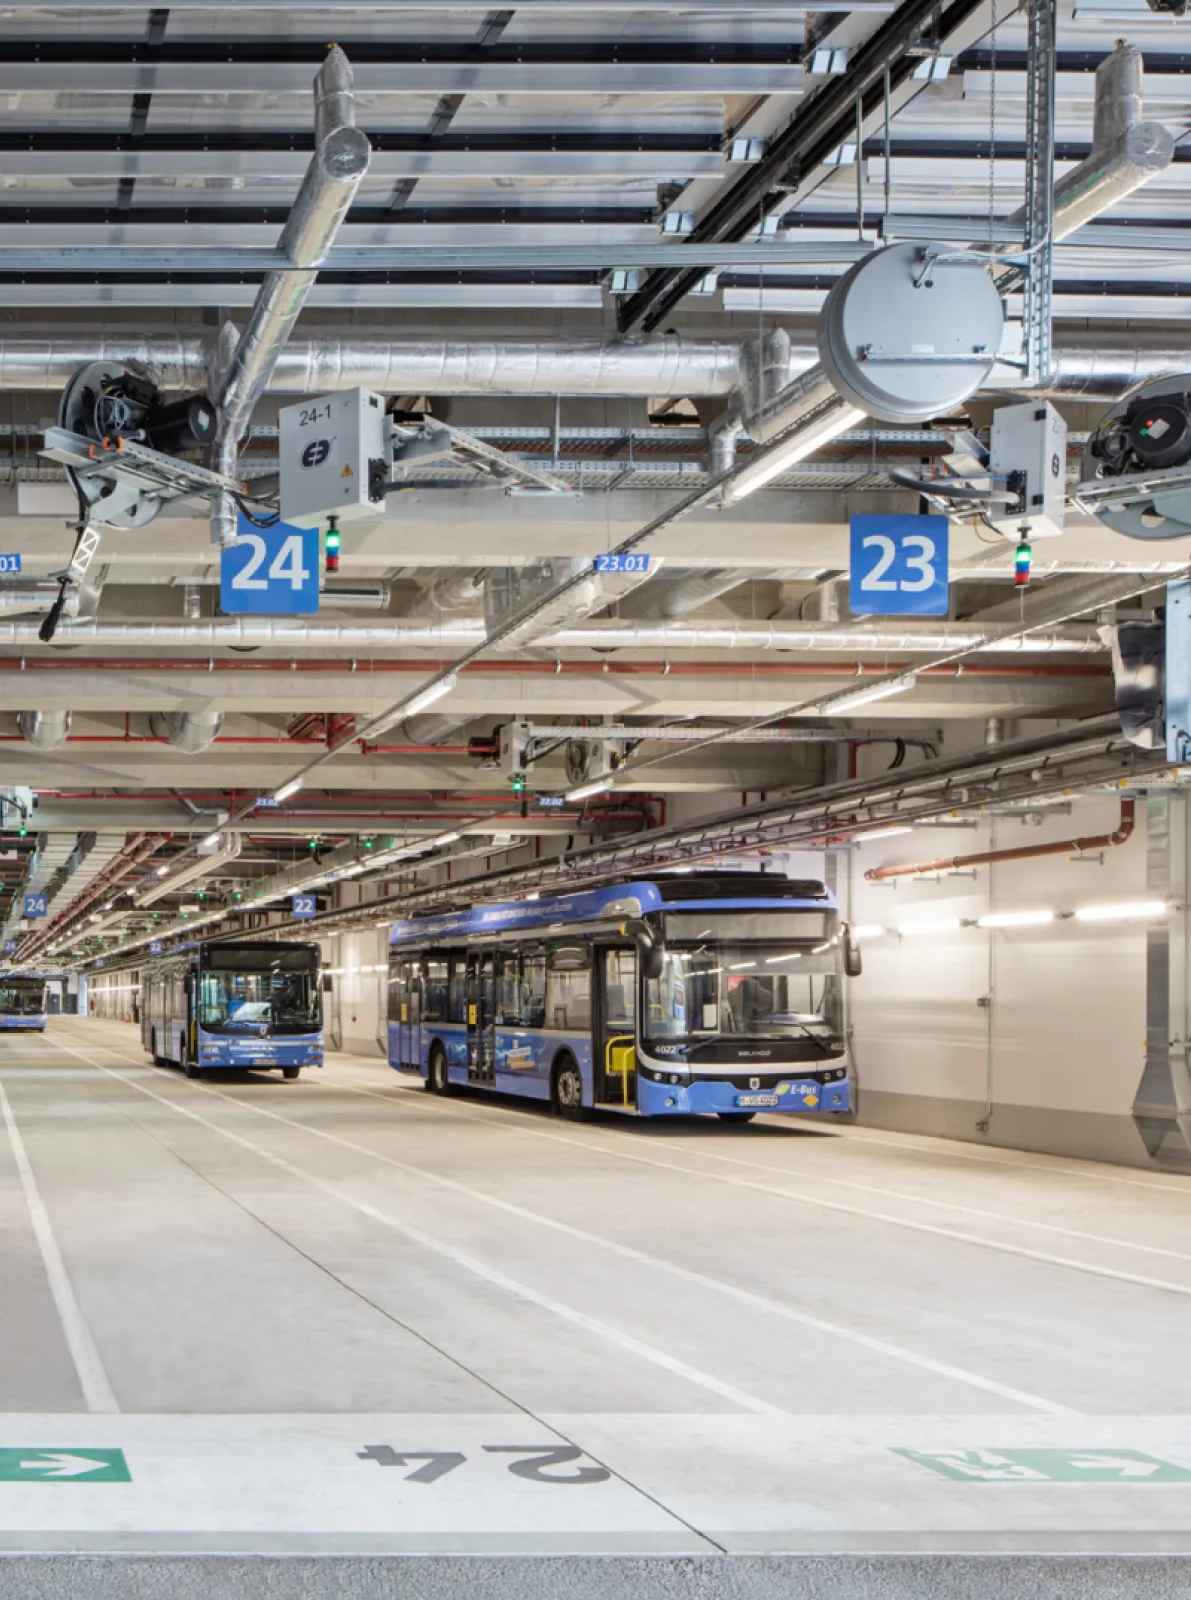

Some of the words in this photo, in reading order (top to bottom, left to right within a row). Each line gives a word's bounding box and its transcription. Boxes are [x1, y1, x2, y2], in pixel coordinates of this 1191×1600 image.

[299, 404, 331, 426] 24-1
[231, 533, 310, 590] 24
[598, 556, 645, 571] 23.01
[860, 535, 936, 592] 23
[27, 899, 45, 912] 24
[295, 899, 313, 913] 22
[655, 1045, 677, 1054] 4022
[791, 1085, 817, 1094] E-Bus
[355, 1444, 612, 1484] 24
